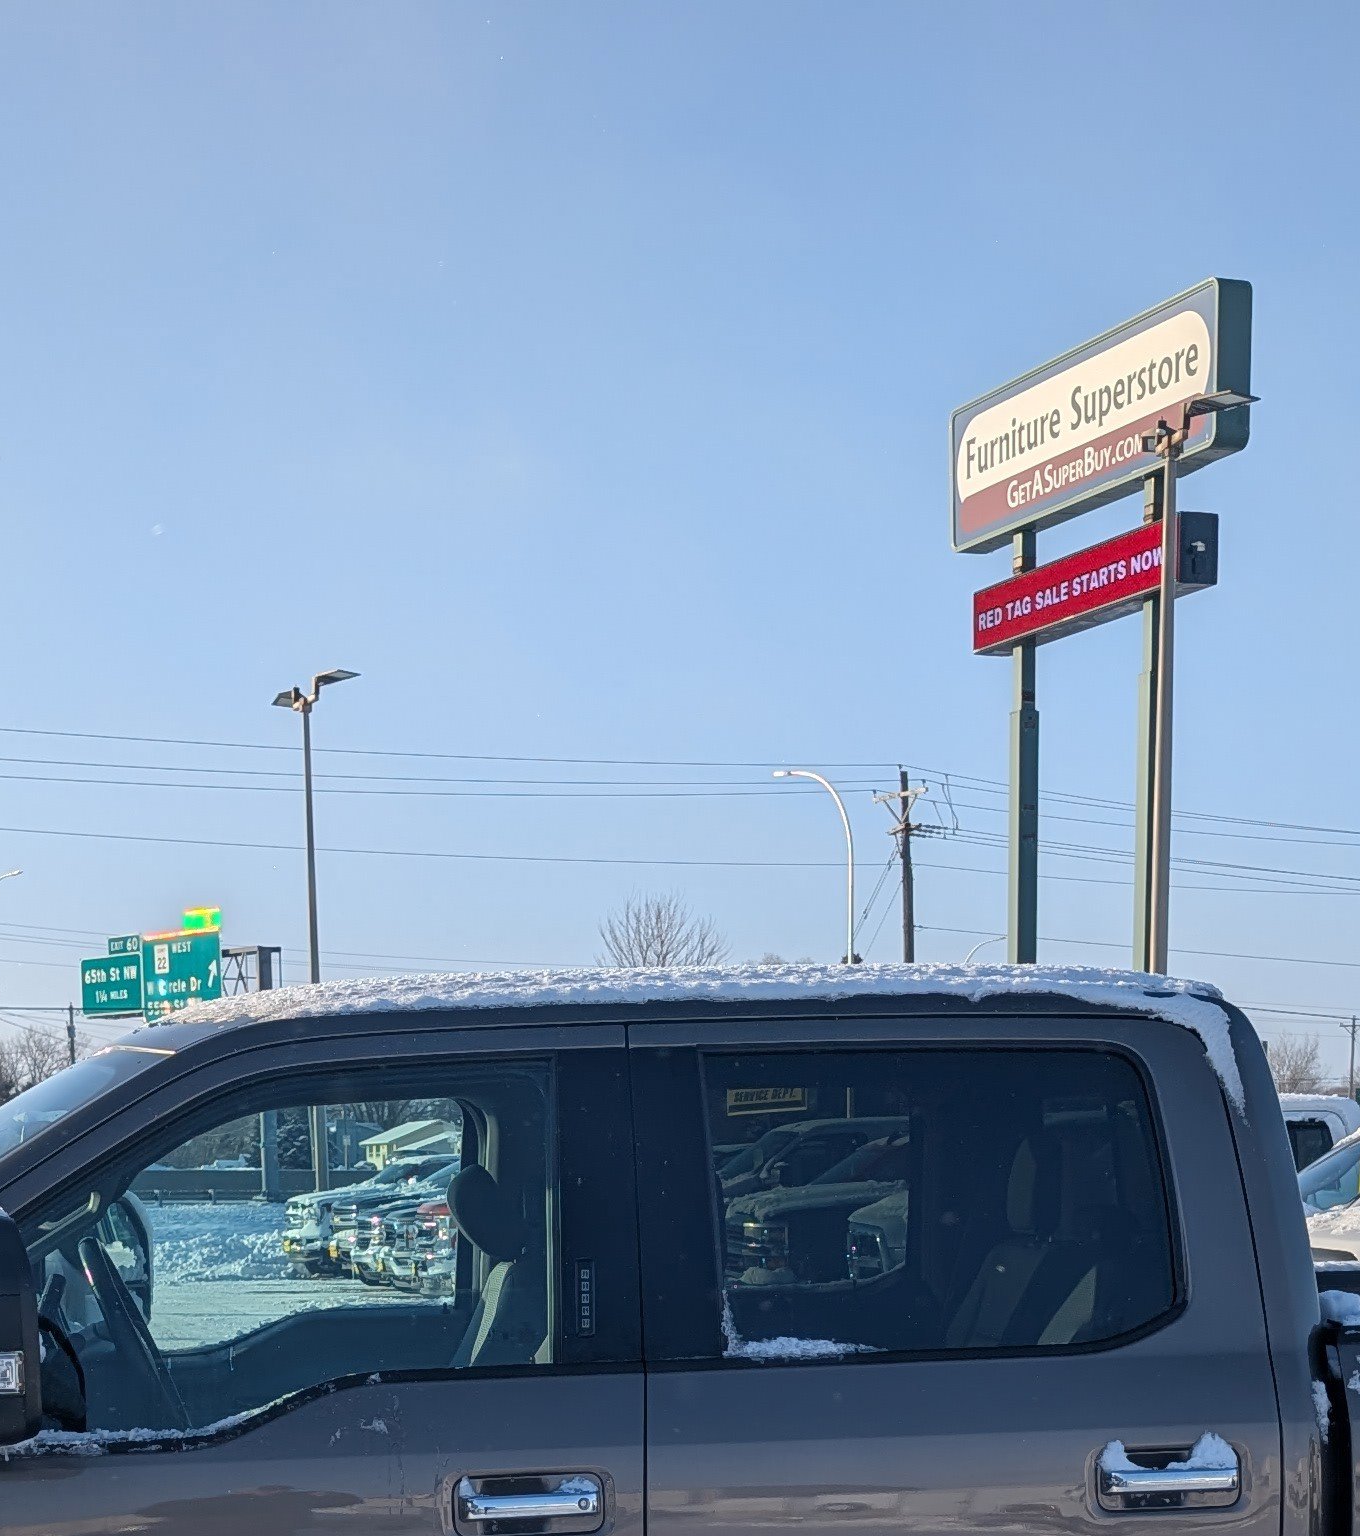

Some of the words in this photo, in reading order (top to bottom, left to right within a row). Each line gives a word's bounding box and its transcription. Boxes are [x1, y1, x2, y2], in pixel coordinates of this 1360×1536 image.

[966, 408, 1061, 480] Furniture
[1070, 343, 1199, 431] Superstore
[978, 606, 1003, 631] RED
[1006, 596, 1032, 621] TAG
[1035, 582, 1069, 611] SALE
[1072, 559, 1127, 597] STARTS
[1130, 546, 1163, 577] NOW
[126, 938, 138, 951] 60
[172, 941, 192, 953] WEST
[157, 957, 167, 970] 22
[84, 968, 107, 984] 65th
[109, 967, 120, 982] St
[123, 965, 138, 980] NW
[190, 976, 202, 992] Dr
[147, 1000, 172, 1016] 55
